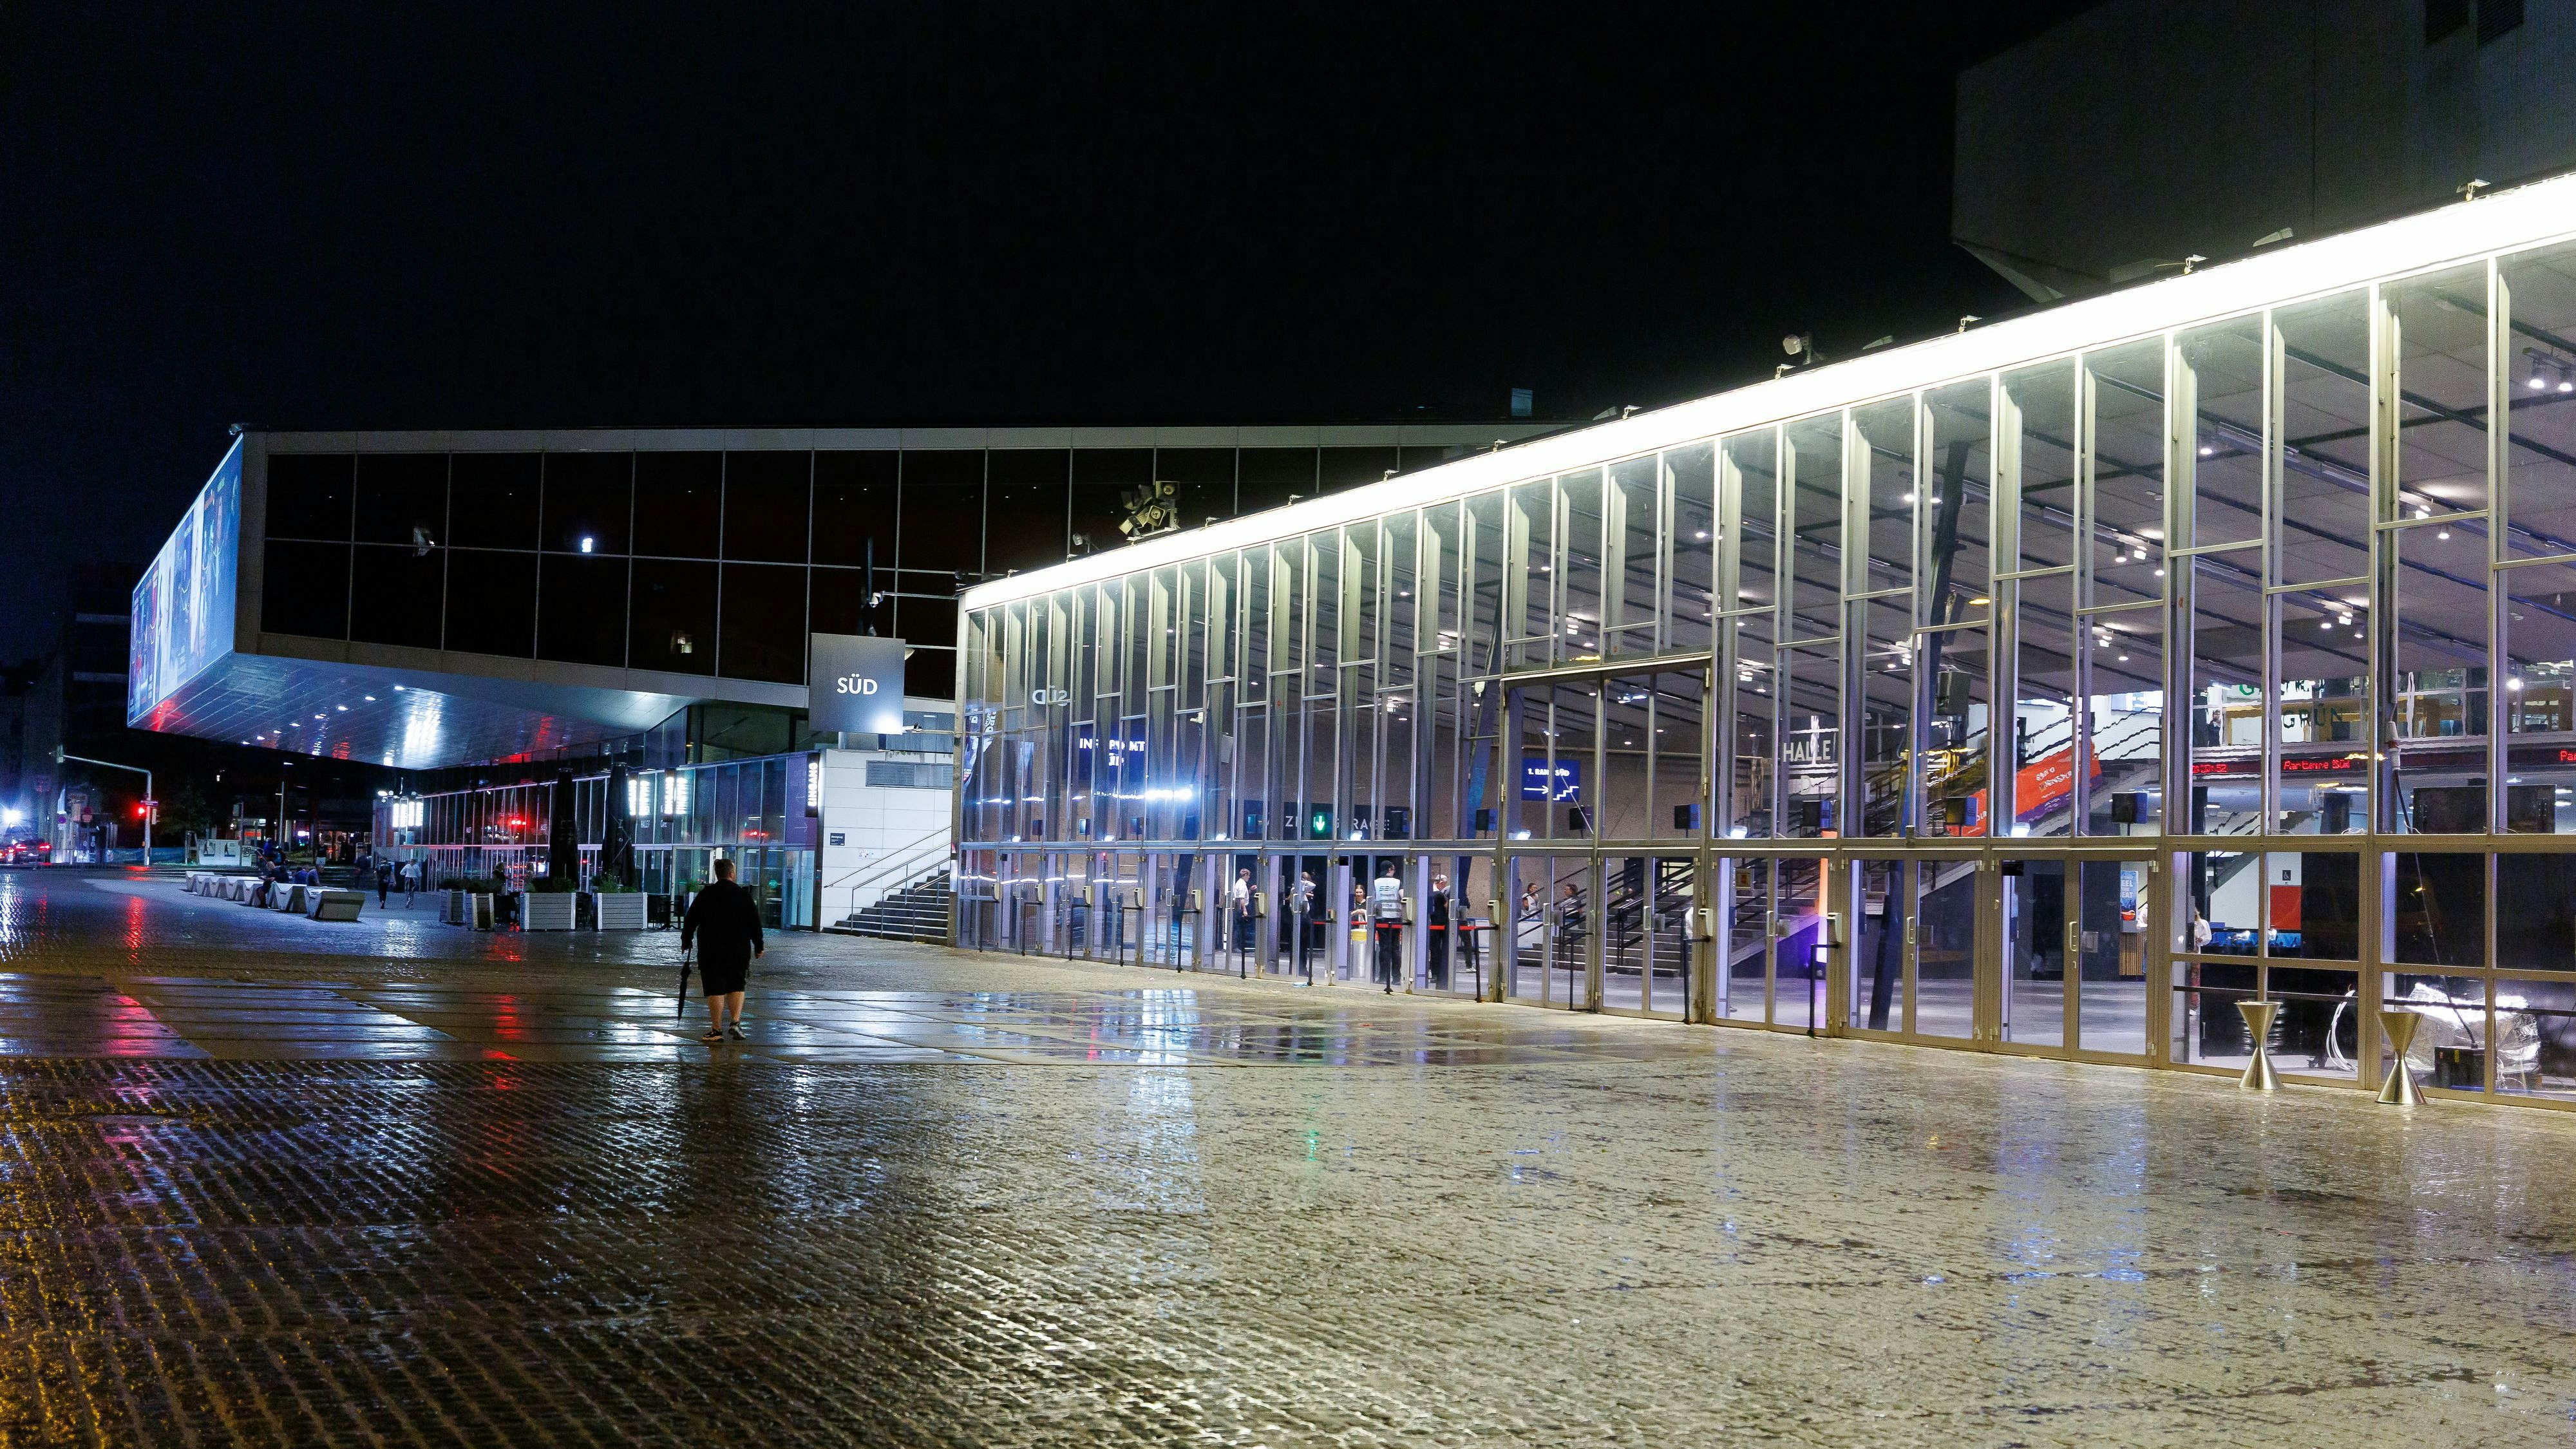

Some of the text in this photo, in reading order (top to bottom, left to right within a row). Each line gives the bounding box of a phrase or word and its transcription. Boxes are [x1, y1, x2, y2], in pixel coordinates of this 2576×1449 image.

[837, 673, 878, 695] SÜD
[1109, 739, 1145, 752] PONT
[1783, 740, 1831, 762] HALLE
[1555, 768, 1570, 777] SÜD
[808, 762, 818, 806] EINGANG
